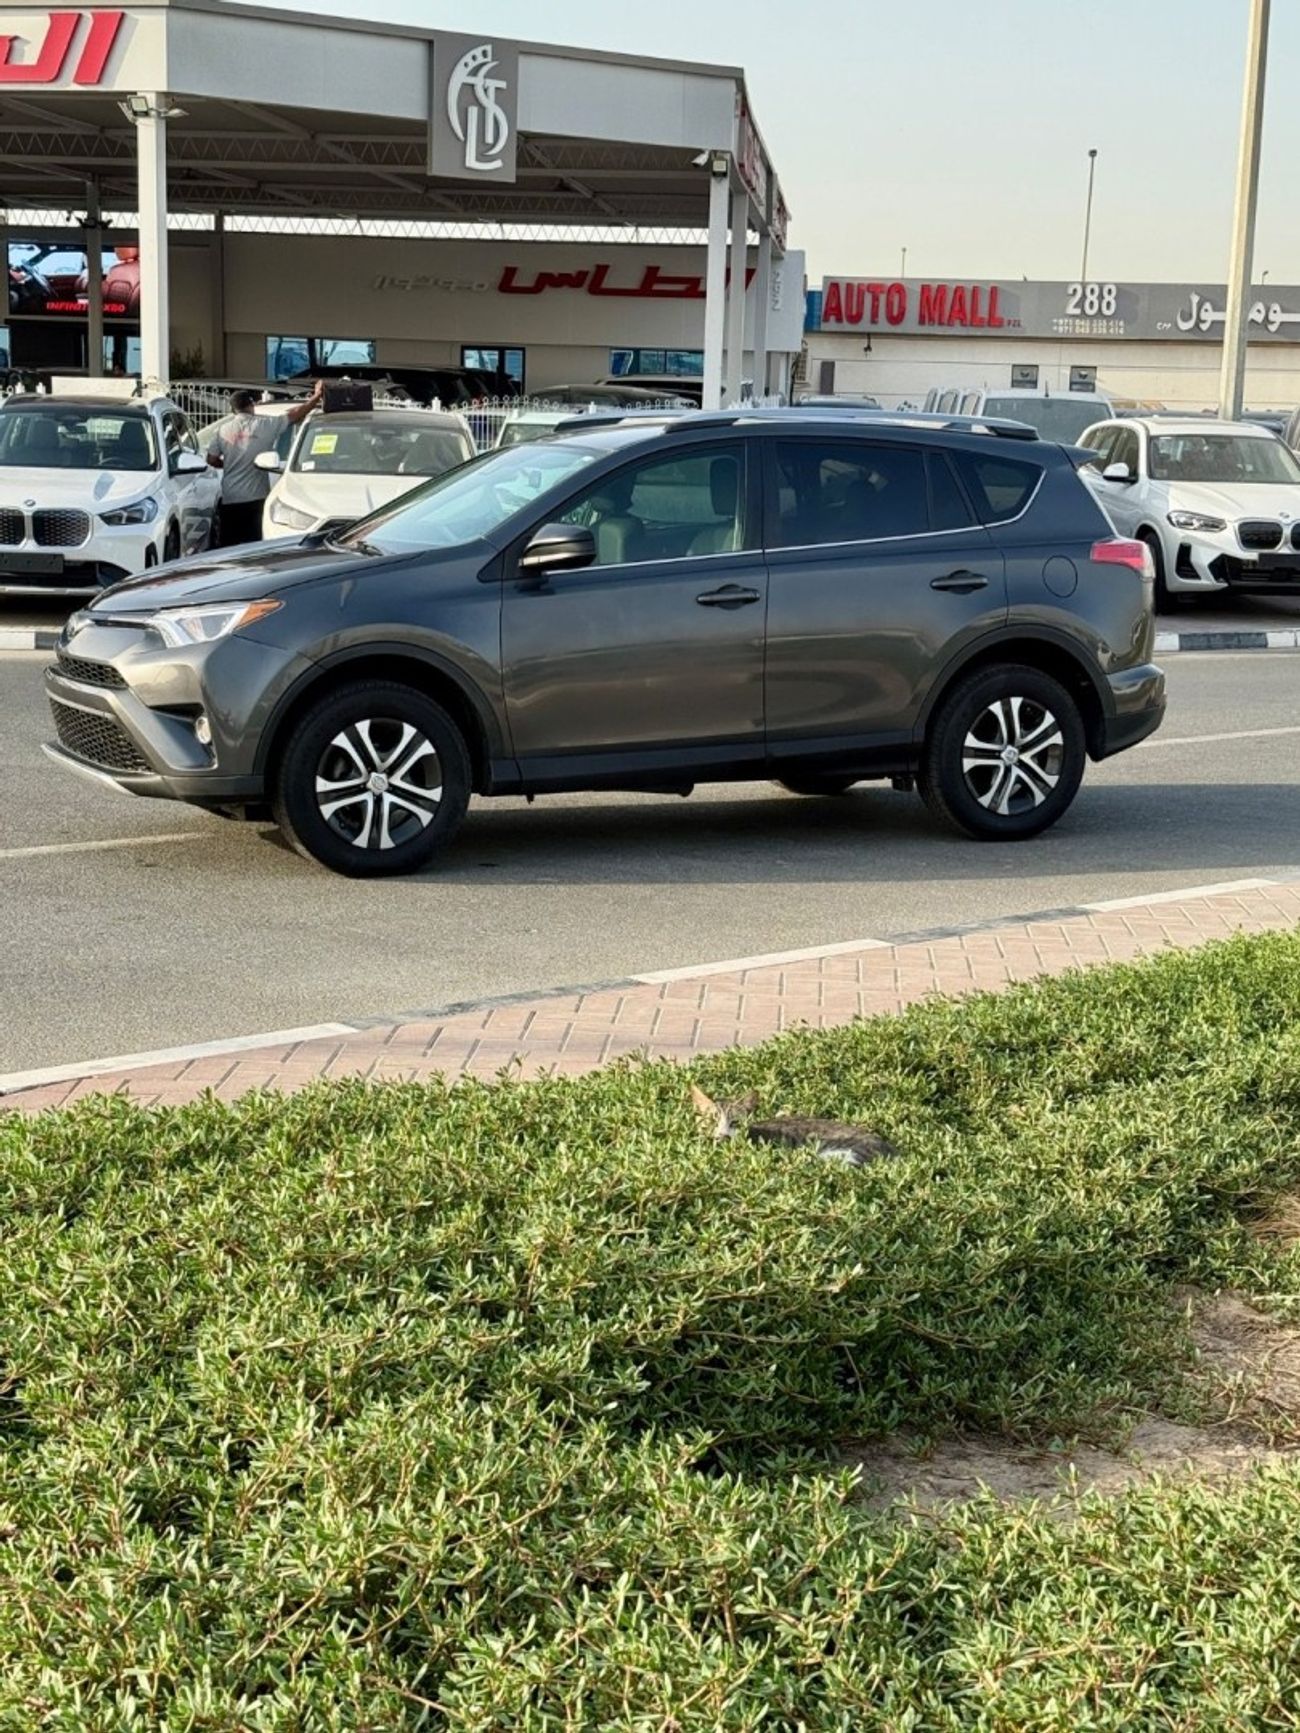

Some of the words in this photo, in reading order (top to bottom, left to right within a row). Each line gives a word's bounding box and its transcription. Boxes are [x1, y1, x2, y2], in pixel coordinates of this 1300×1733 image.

[46, 301, 88, 312] INFINIT
[102, 303, 126, 313] X80
[822, 282, 907, 326] AUTO
[918, 284, 1004, 328] MALL
[1065, 283, 1117, 316] 288
